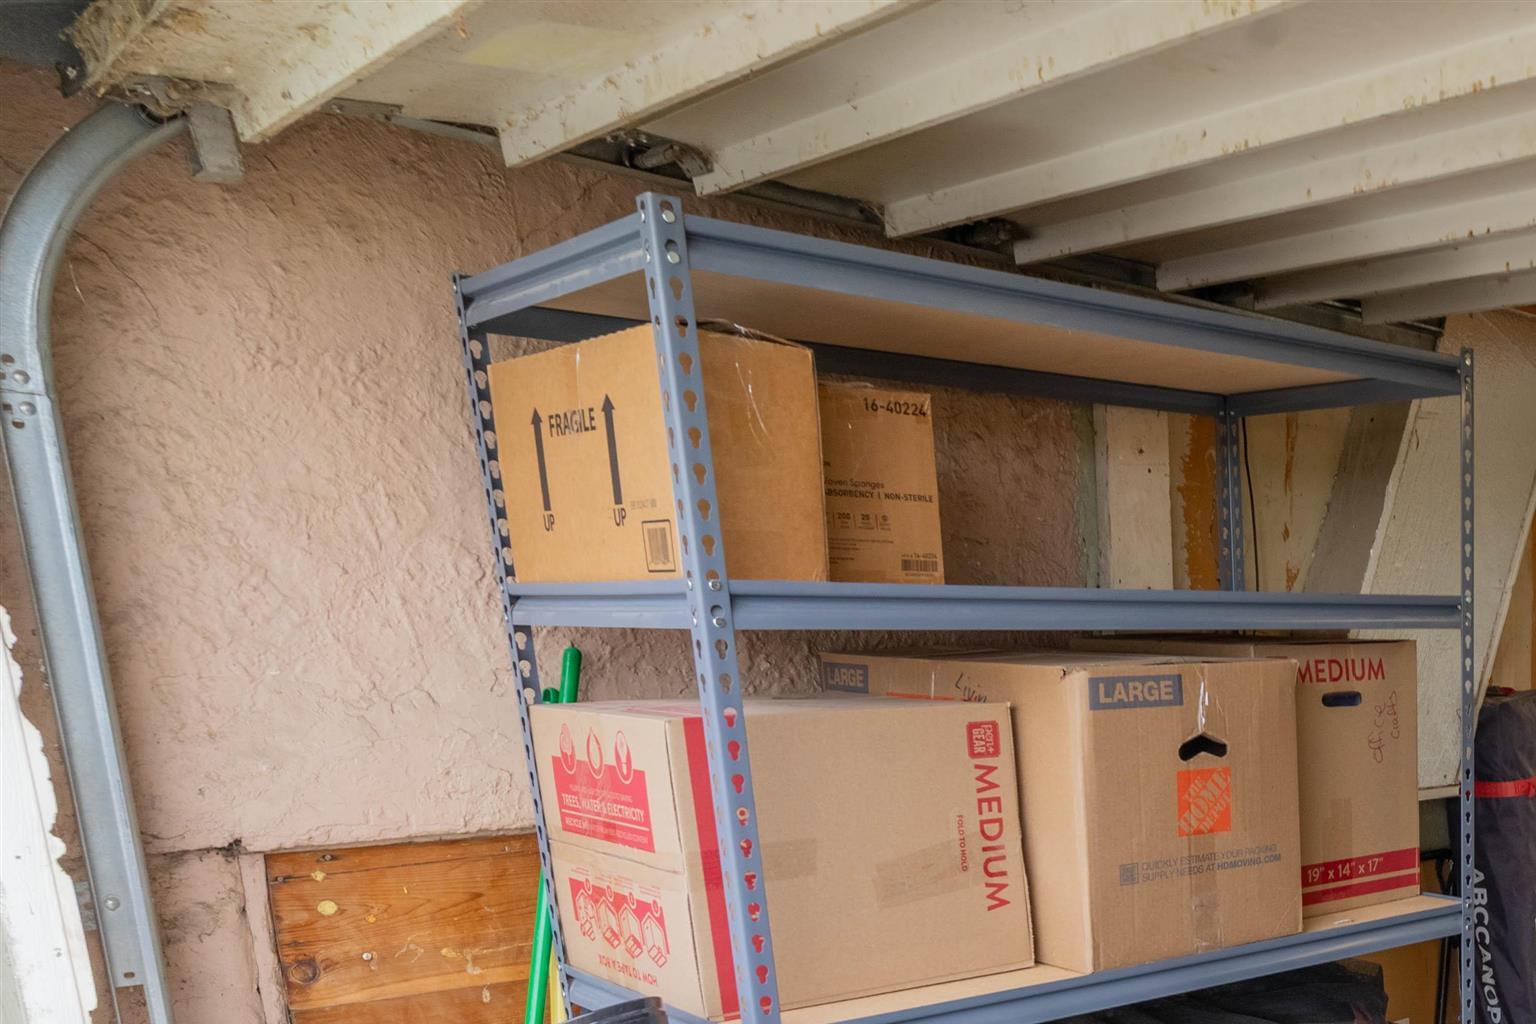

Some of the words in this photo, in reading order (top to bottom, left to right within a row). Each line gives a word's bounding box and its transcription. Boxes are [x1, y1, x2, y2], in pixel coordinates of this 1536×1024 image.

[862, 397, 929, 417] 16-40224
[548, 407, 597, 438] FRAGILE
[884, 493, 934, 504] NON-STERILE
[543, 514, 556, 532] UP
[613, 507, 627, 527] UP
[827, 668, 865, 688] LARGE
[1297, 657, 1386, 684] MEDIUM
[1098, 680, 1174, 705] LARGE
[972, 728, 985, 754] GEAR
[1178, 769, 1230, 834] HOME
[956, 814, 965, 837] FOLD
[959, 837, 967, 849] TO
[973, 763, 1011, 912] MEDIUM
[960, 849, 969, 873] HOLD
[1205, 863, 1217, 873] AT
[1217, 853, 1282, 871] HDMOVING.COM
[1220, 848, 1243, 860] YOUR
[1307, 867, 1325, 883] 19"
[1338, 861, 1356, 879] 14"
[1368, 857, 1385, 873] 17"
